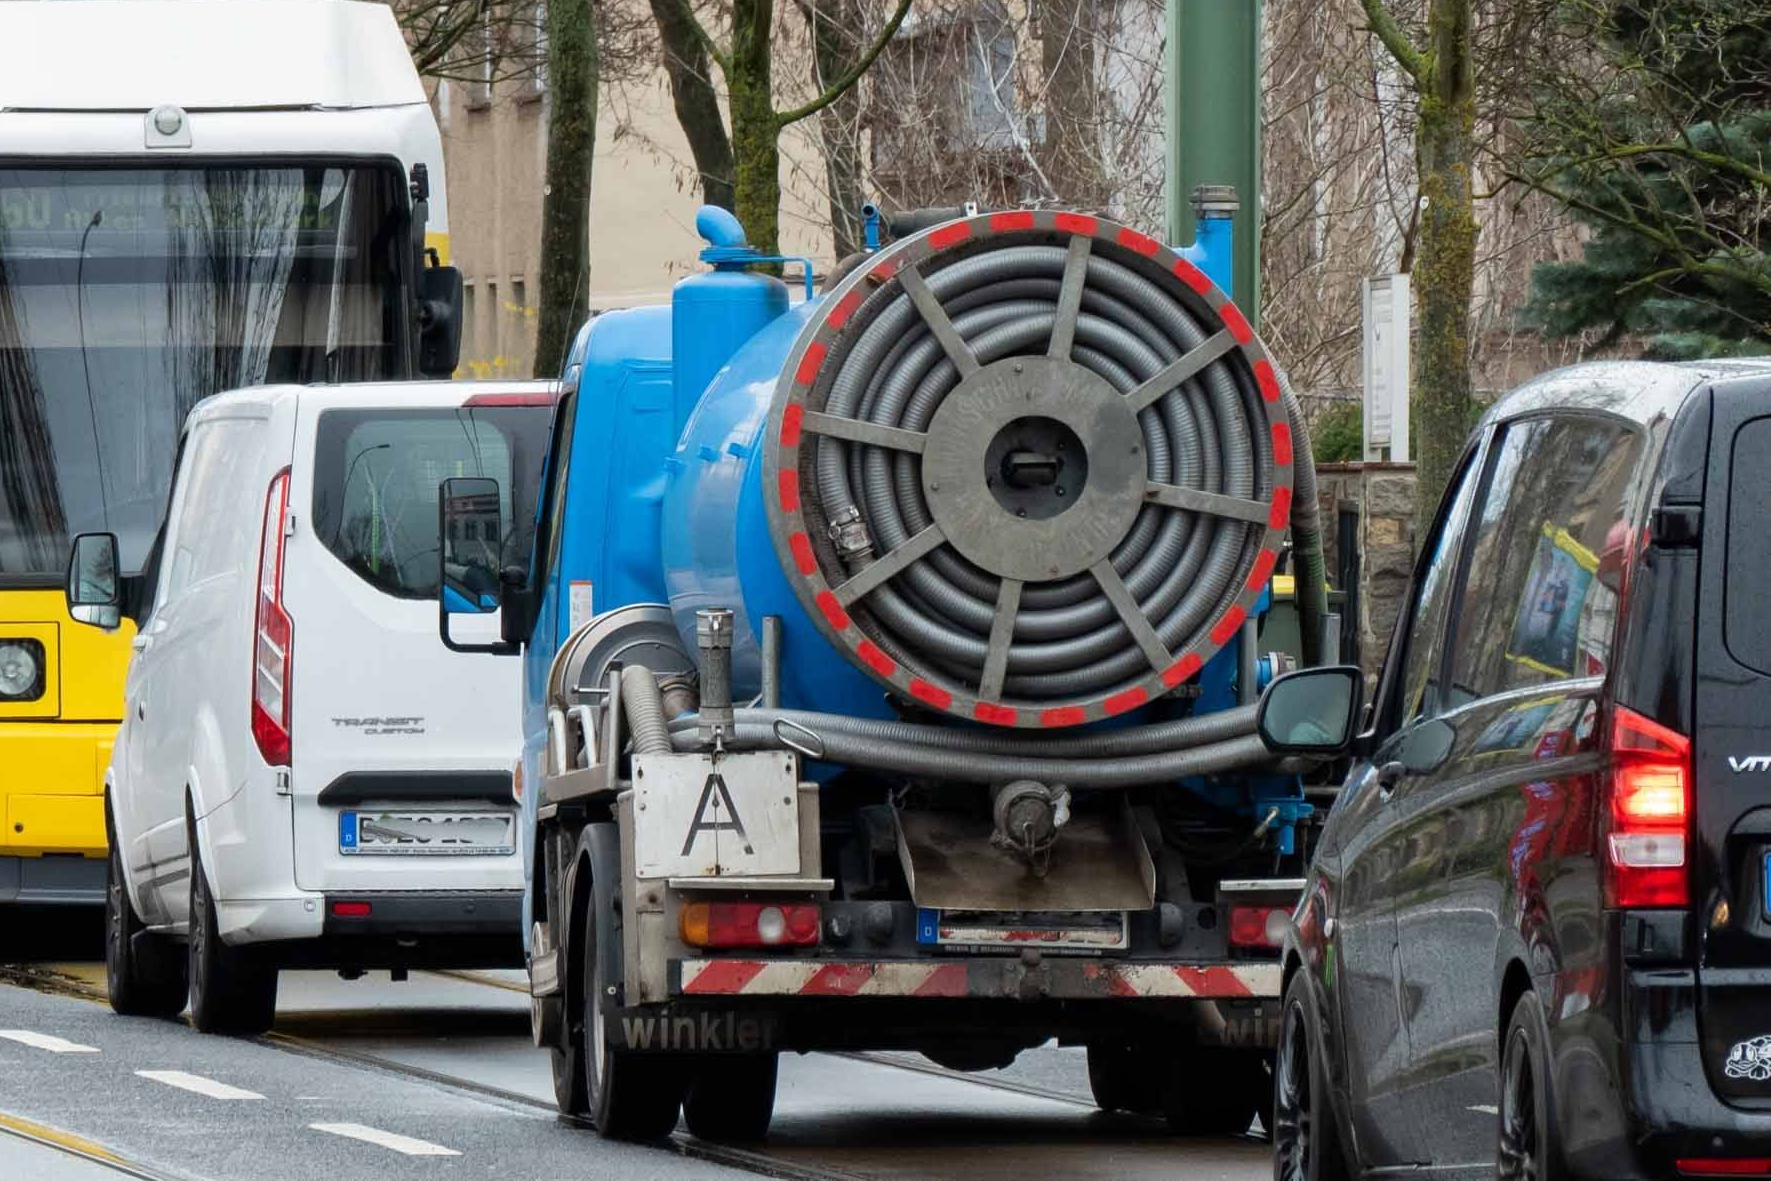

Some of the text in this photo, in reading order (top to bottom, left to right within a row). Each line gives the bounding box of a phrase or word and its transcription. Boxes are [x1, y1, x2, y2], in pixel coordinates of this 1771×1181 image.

[332, 717, 425, 726] TRANSIT
[364, 727, 426, 736] CUSTOM
[681, 774, 755, 856] A
[621, 1008, 773, 1050] winkler
